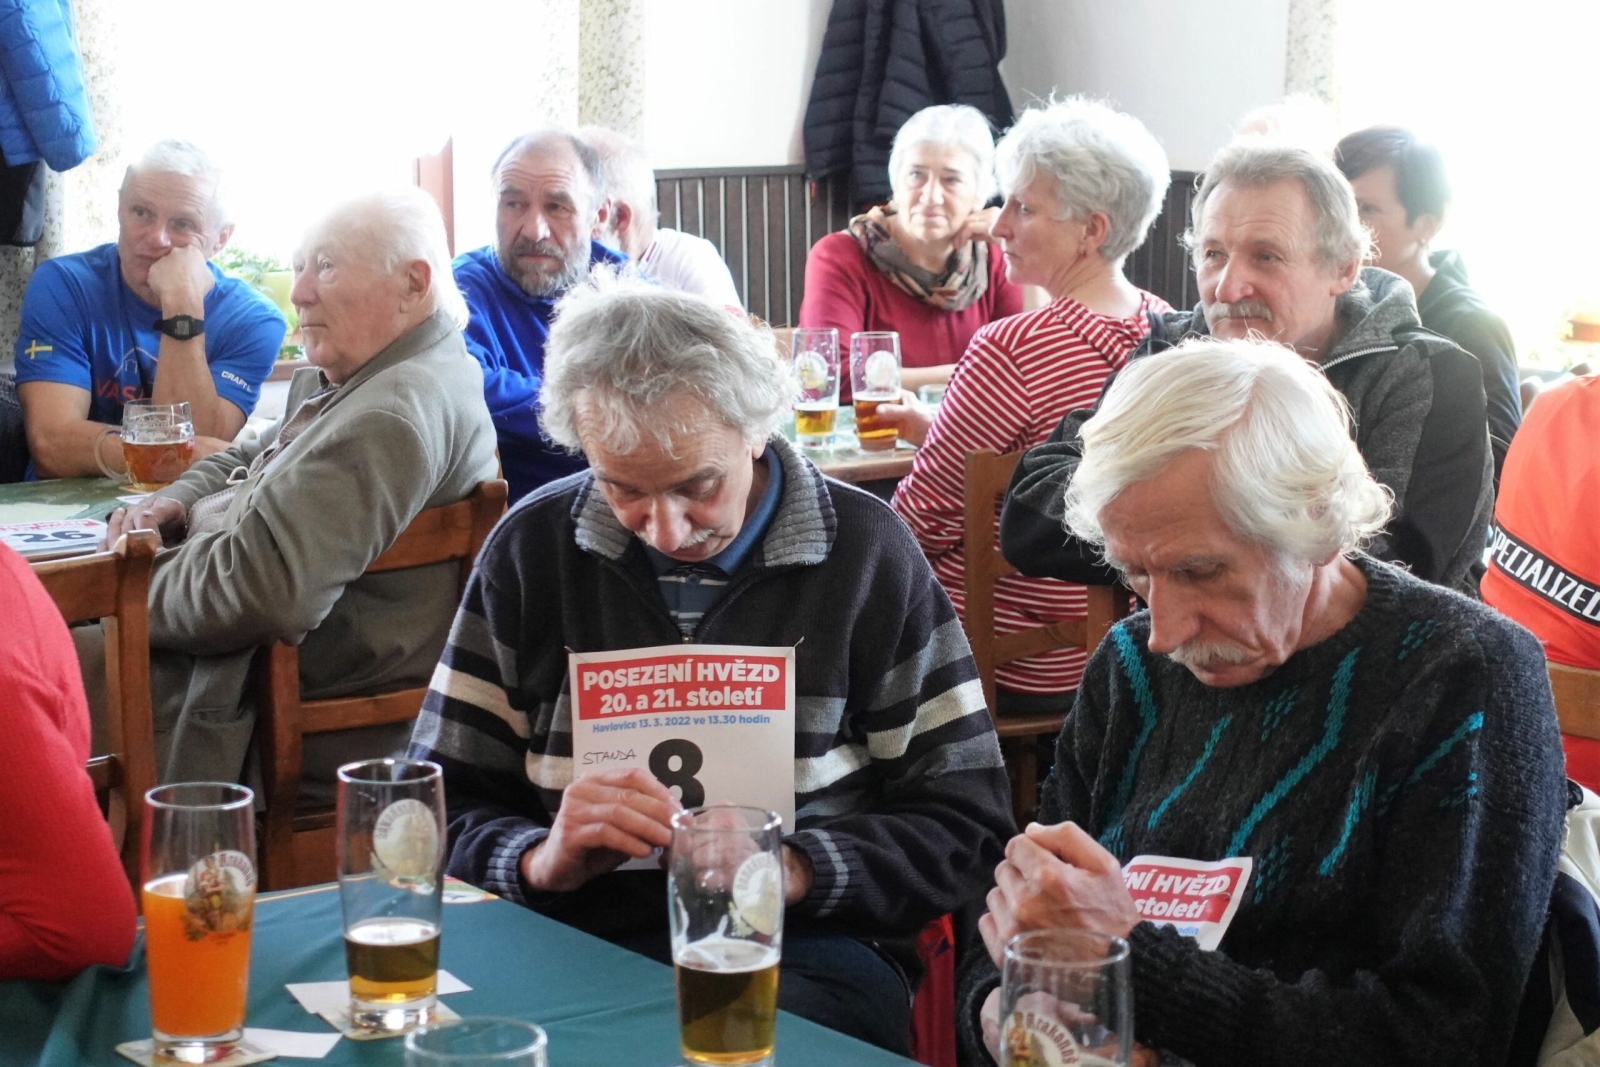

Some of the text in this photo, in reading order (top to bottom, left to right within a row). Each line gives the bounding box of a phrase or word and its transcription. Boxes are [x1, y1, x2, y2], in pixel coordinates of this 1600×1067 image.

[96, 377, 145, 405] VAS
[221, 370, 248, 390] CRAFT
[10, 530, 97, 543] 26
[583, 658, 780, 691] POSEZENÍ HVĚZD
[600, 686, 764, 714] 20. a 21. století
[592, 714, 771, 734] Havlovice 13. 3. 2022 ve 13.30 hodin
[649, 738, 705, 814] 8
[1152, 873, 1231, 897] HVĚZD
[1133, 896, 1209, 918] století
